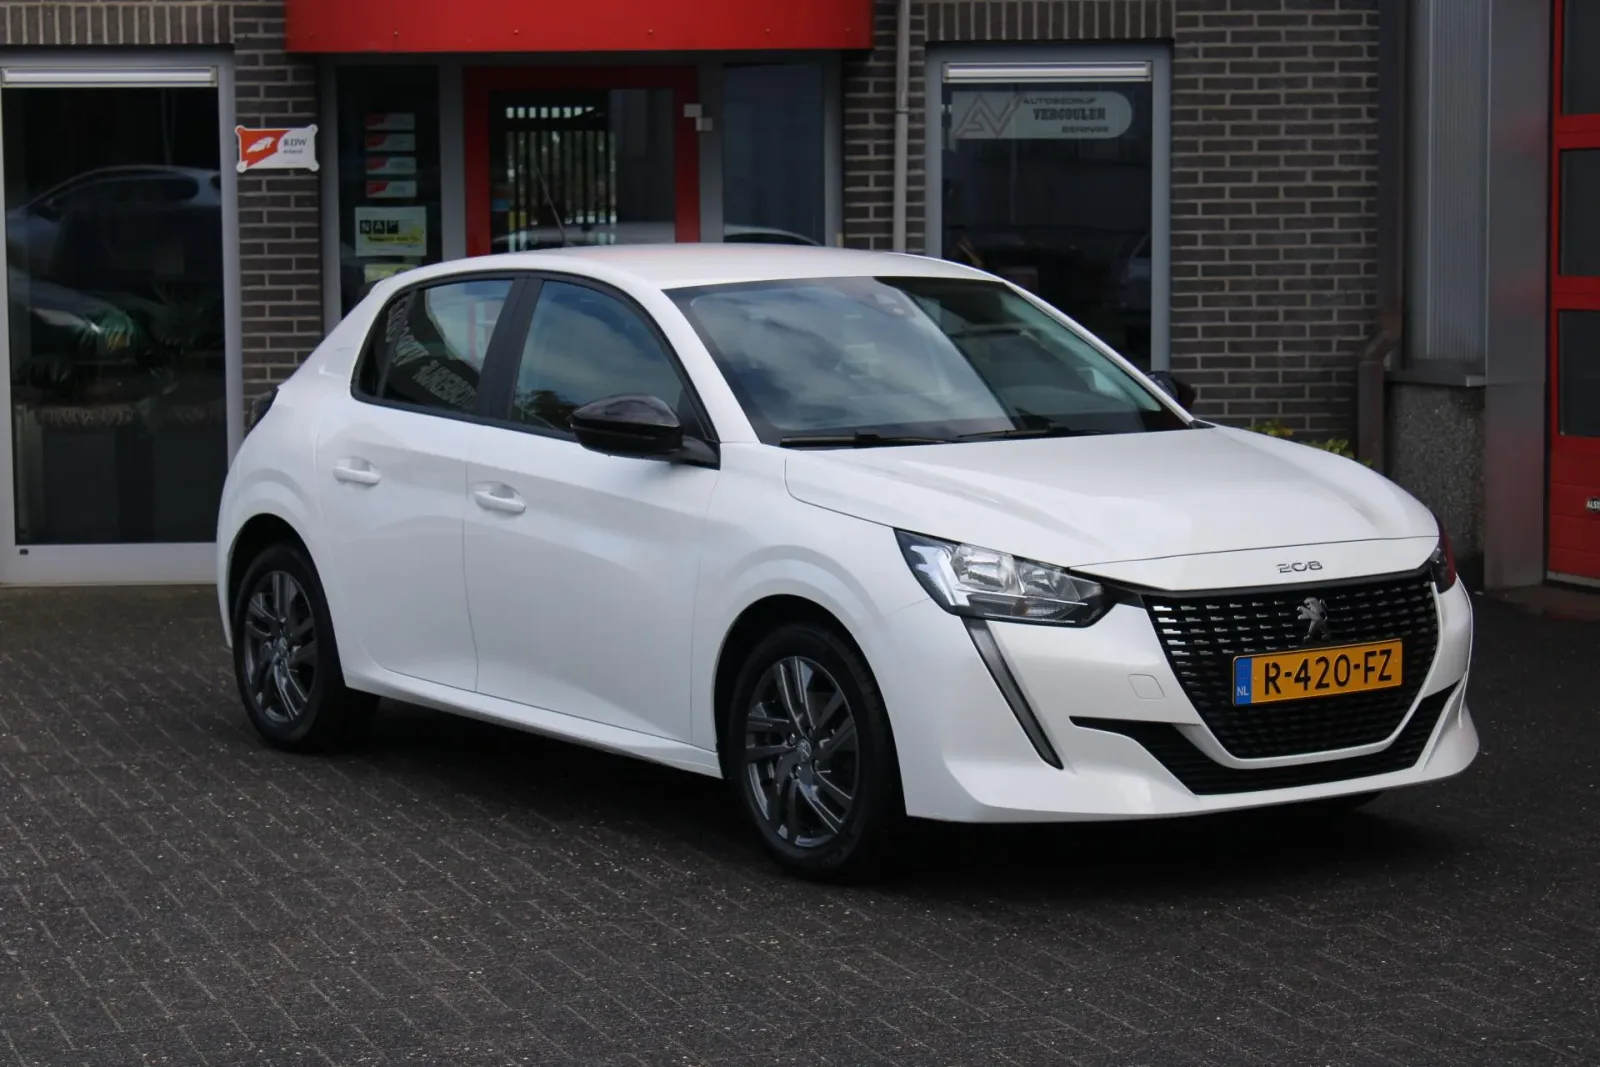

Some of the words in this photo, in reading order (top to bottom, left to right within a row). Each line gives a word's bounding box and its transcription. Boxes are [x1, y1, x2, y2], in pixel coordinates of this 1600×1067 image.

[283, 137, 307, 147] RDW
[360, 219, 398, 235] NAP
[1275, 560, 1323, 574] 208
[1264, 649, 1393, 695] R-420-FZ
[1236, 686, 1249, 696] NL
